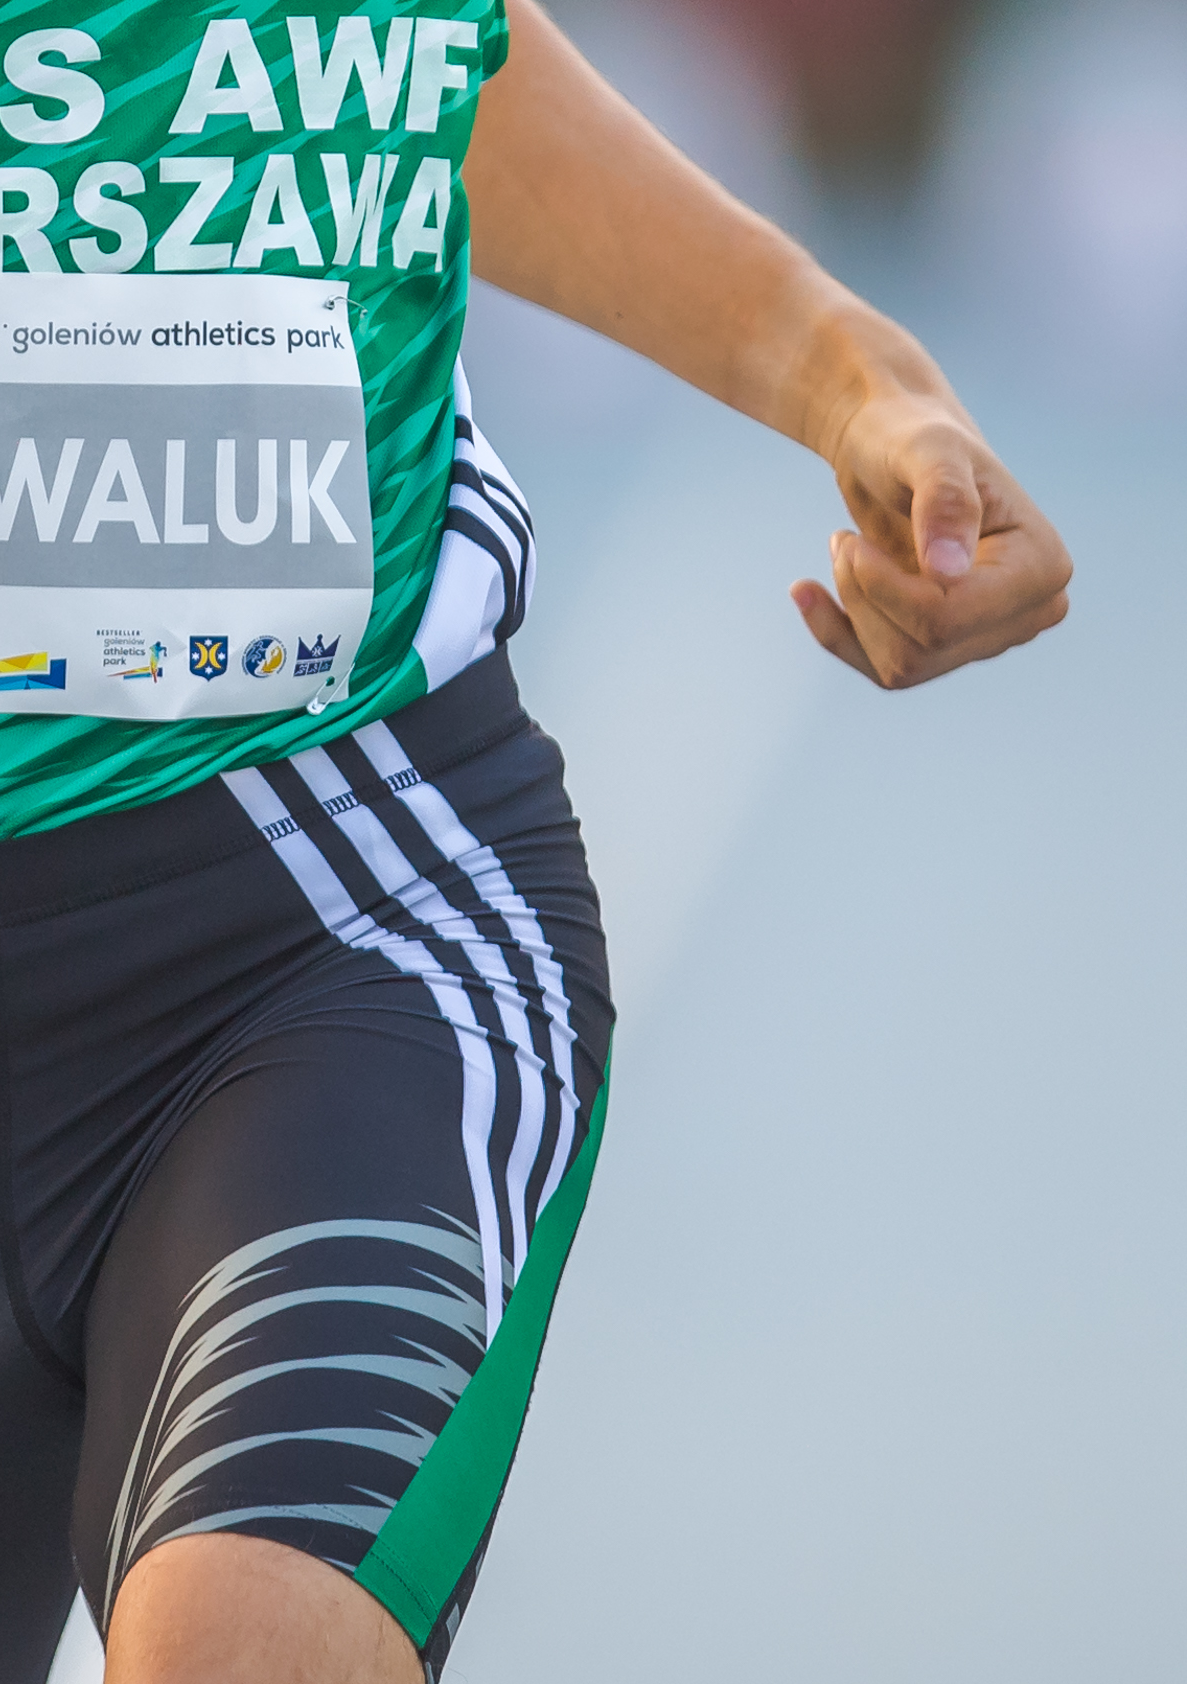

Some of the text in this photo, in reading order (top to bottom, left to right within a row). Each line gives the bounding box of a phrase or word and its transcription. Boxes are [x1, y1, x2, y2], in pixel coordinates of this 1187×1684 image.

[168, 16, 479, 133] AWF
[12, 322, 142, 354] goleniów
[151, 320, 276, 346] athletics
[286, 325, 345, 353] park
[103, 637, 146, 647] goleniów
[103, 646, 146, 656] athletics
[103, 656, 126, 667] park
